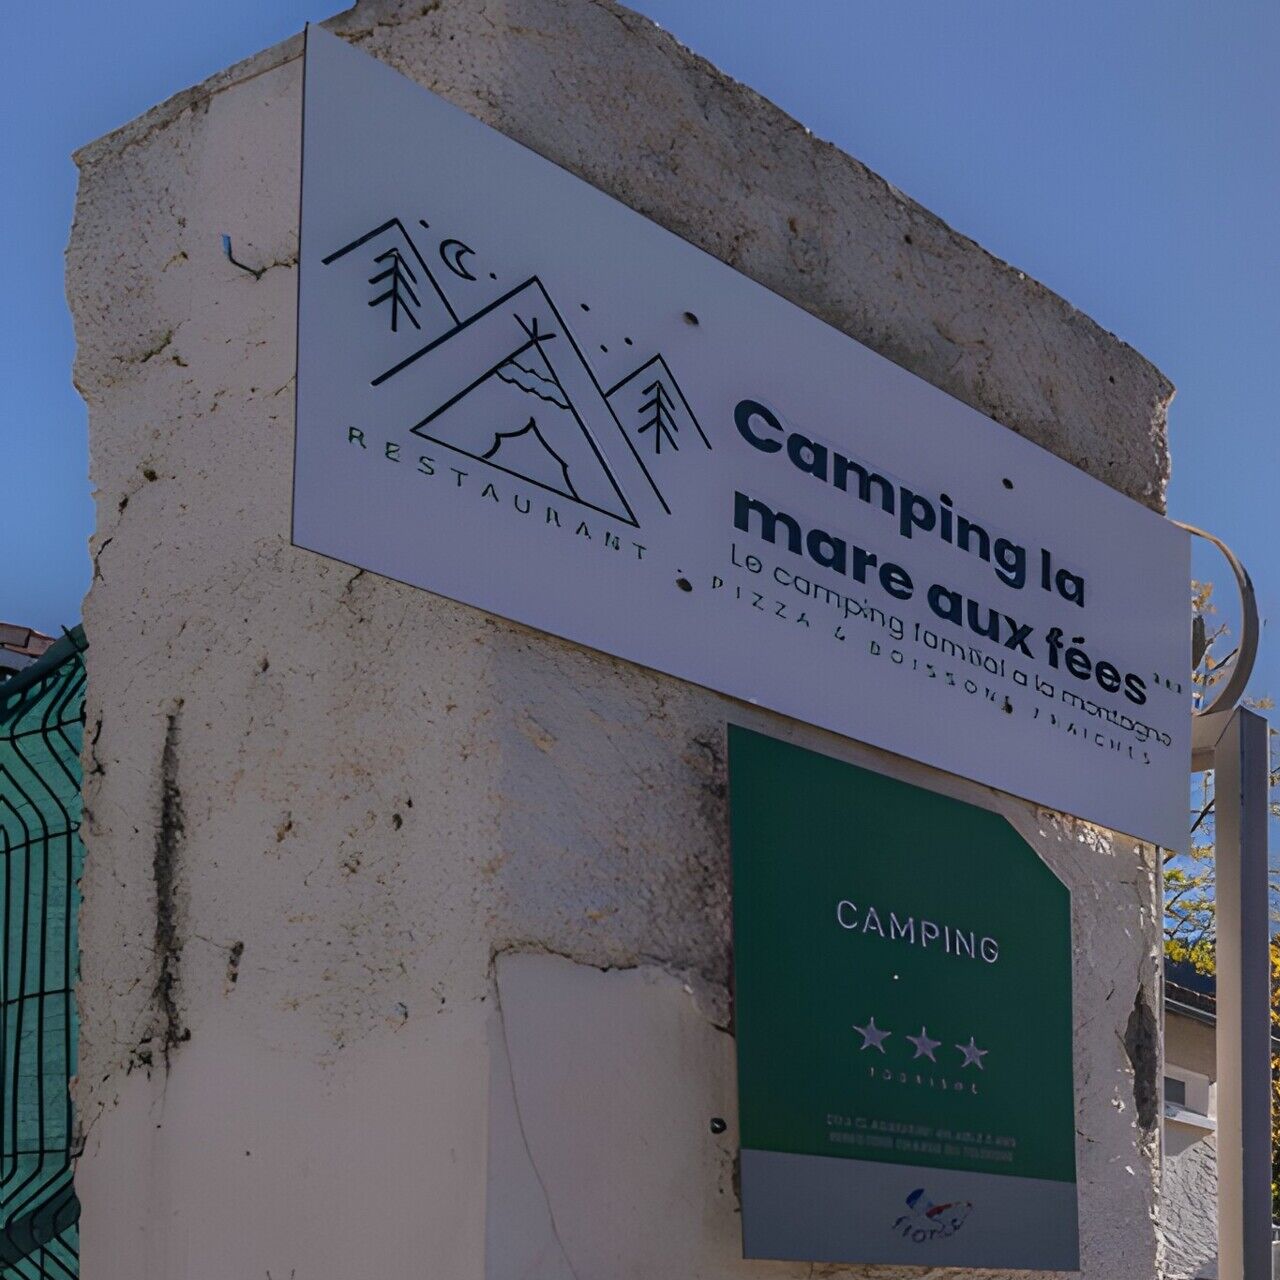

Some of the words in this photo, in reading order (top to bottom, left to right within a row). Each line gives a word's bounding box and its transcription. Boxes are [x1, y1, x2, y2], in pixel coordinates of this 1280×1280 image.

[347, 425, 648, 560] RESTAURANT
[733, 399, 1027, 590] Camping
[1040, 548, 1085, 608] la
[733, 489, 915, 601] mare
[927, 584, 1035, 660] aux
[1045, 626, 1147, 706] fées
[773, 566, 905, 641] camping
[836, 899, 1000, 964] CAMPING
